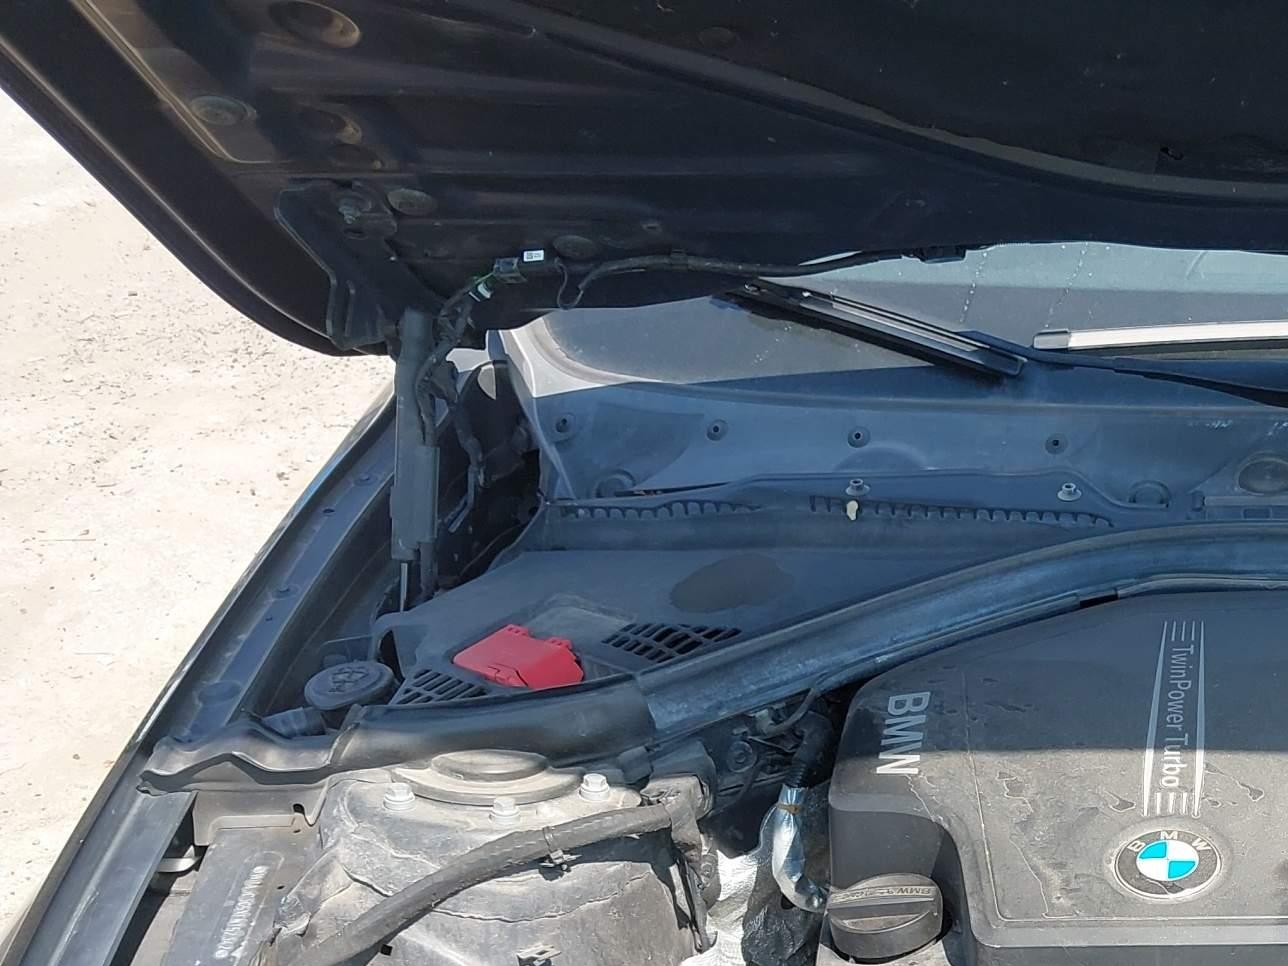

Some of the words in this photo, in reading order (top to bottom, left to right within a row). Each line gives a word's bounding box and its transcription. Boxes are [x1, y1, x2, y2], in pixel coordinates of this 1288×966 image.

[1166, 644, 1194, 731] TwinPower
[876, 691, 931, 774] BMW
[1161, 733, 1189, 788] Turbo
[1126, 830, 1212, 852] BMW
